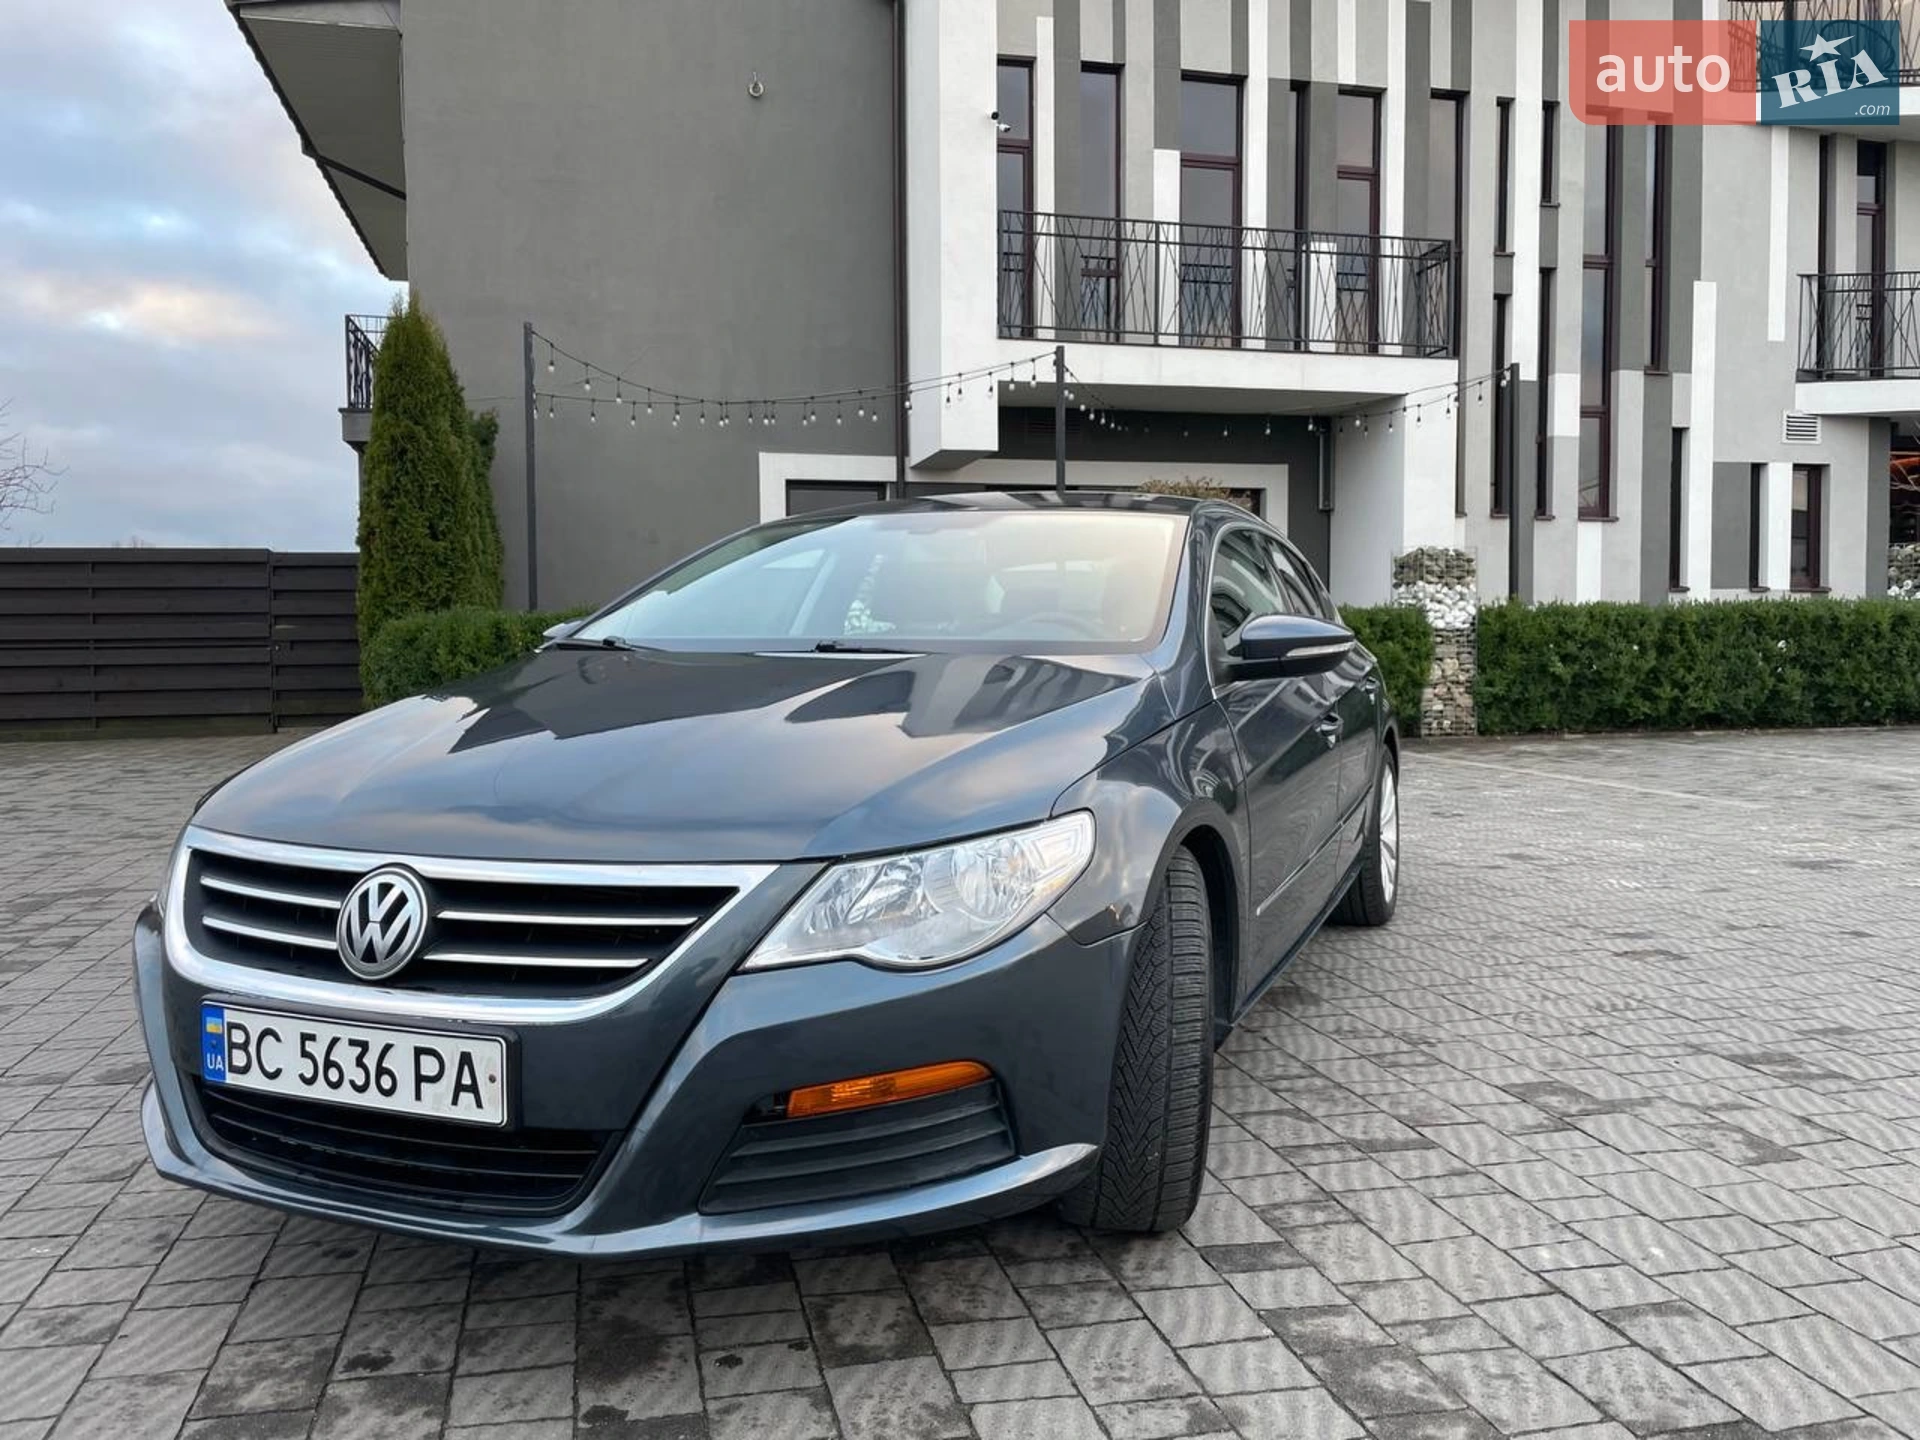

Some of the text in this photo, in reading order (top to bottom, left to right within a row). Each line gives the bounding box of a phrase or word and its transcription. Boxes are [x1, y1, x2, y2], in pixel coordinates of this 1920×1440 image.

[342, 872, 420, 967] VW
[206, 1053, 225, 1072] UA
[226, 1020, 484, 1110] BC 5636 PA
